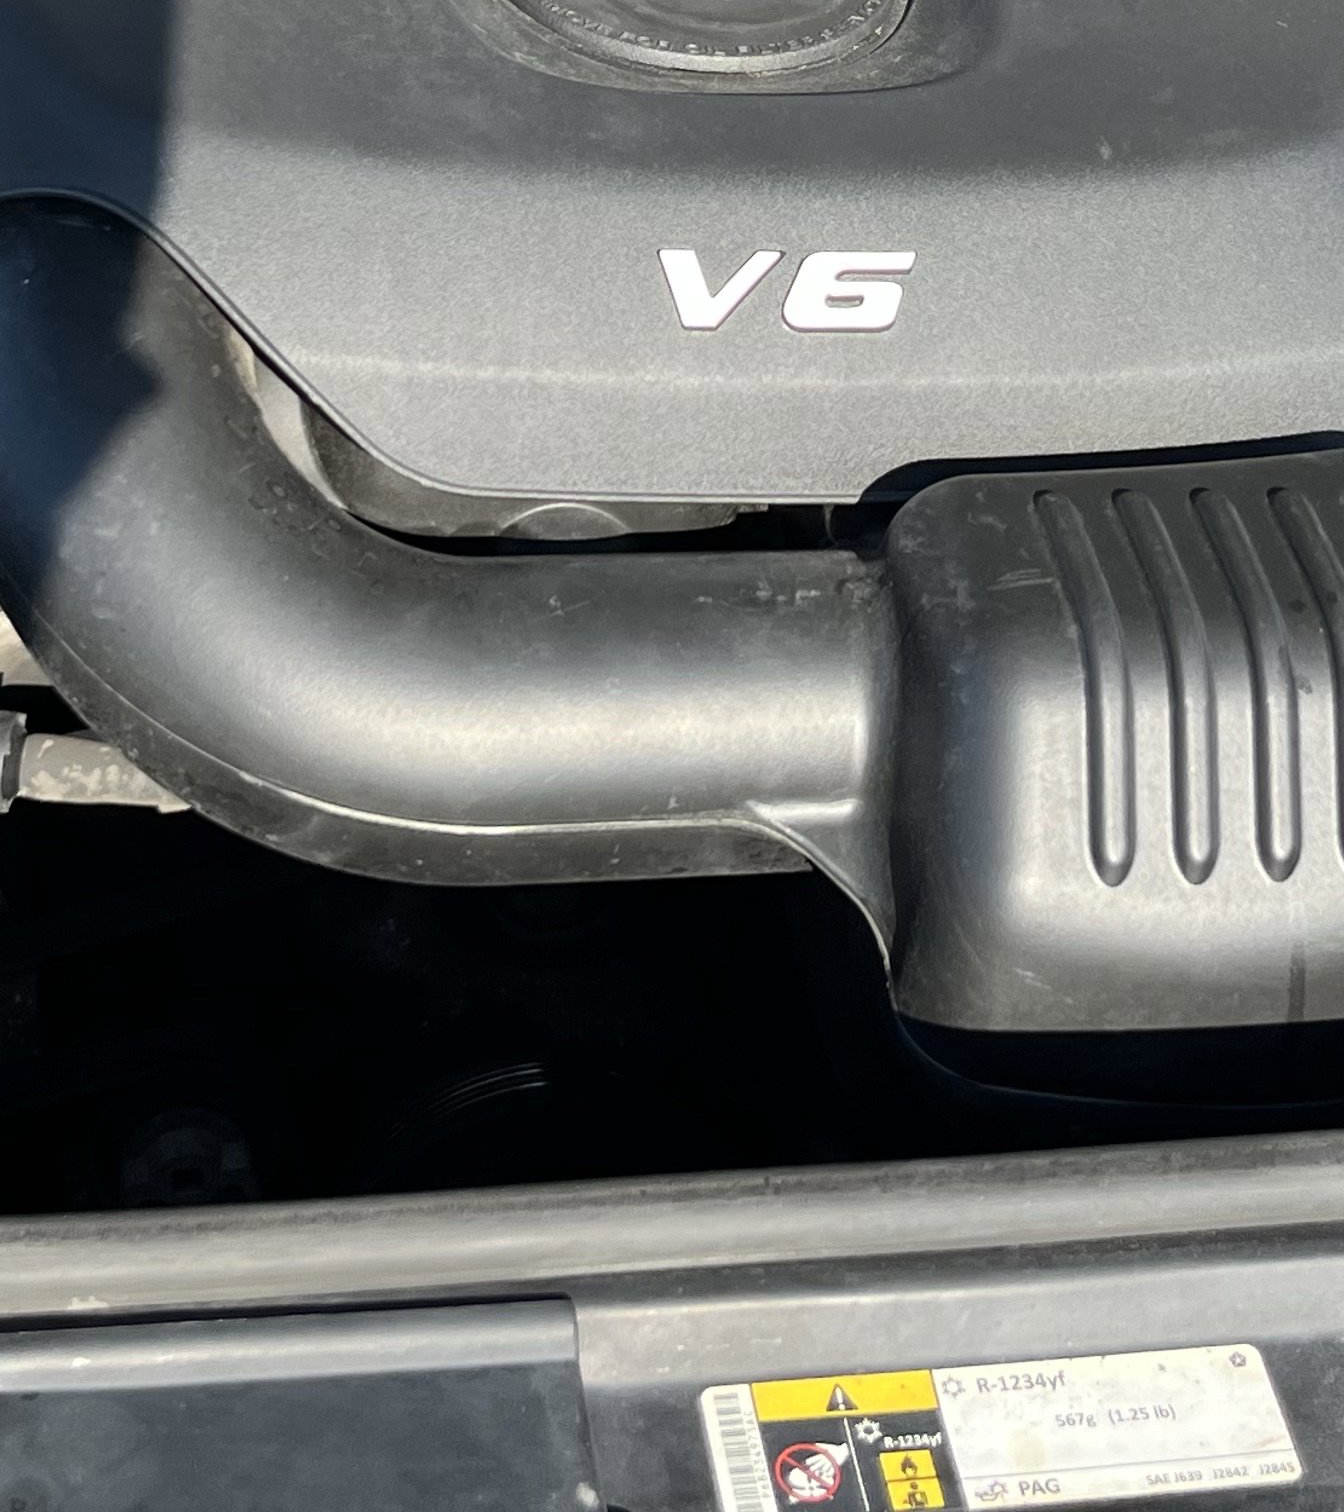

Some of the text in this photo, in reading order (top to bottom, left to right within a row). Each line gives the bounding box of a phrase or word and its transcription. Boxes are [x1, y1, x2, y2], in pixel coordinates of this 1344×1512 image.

[657, 248, 917, 333] V6
[976, 1370, 1066, 1393] R-1234yf
[1055, 1403, 1177, 1428] 567g (1.25 lb)
[1018, 1477, 1062, 1497] PAG
[1145, 1473, 1172, 1486] SAE
